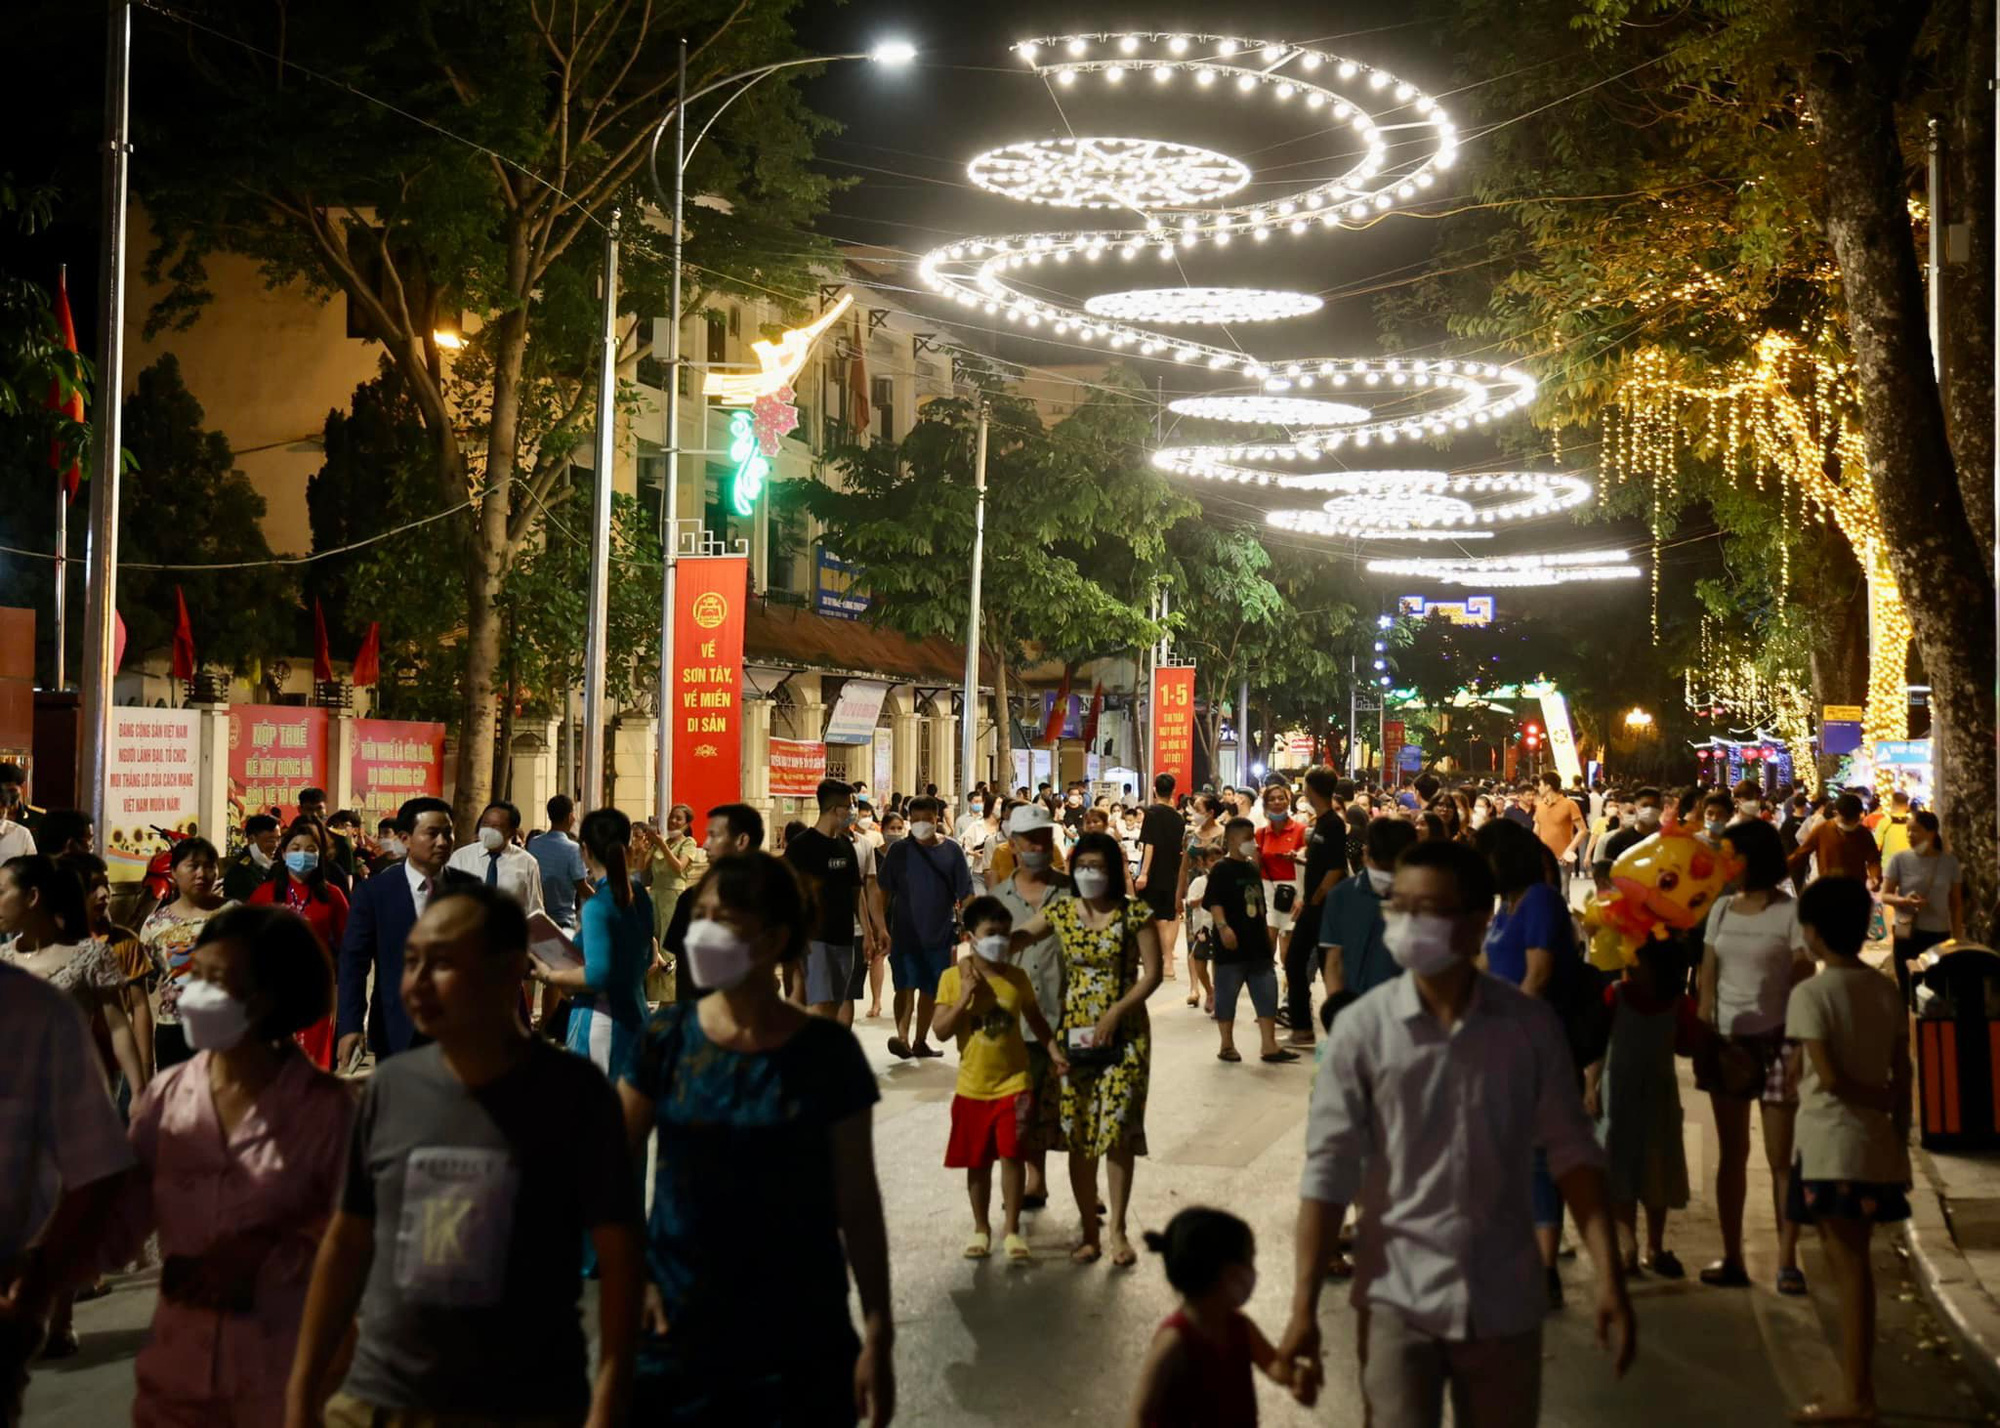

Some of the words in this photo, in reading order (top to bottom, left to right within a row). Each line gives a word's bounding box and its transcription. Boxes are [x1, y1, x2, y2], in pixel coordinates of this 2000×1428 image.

[701, 638, 715, 658] VỀ
[683, 667, 706, 683] SƠN
[710, 664, 732, 684] TÂY,
[684, 688, 697, 708] VỀ
[700, 687, 731, 708] MIỀN
[164, 722, 174, 740] VIỆT
[176, 725, 188, 738] NAM
[687, 718, 698, 733] DI
[702, 712, 726, 733] SẢN
[252, 719, 277, 752] NỘP
[280, 718, 308, 748] THUẾ
[246, 752, 259, 778] ĐỂ
[246, 780, 264, 806] BẢO
[136, 798, 148, 812] NAM
